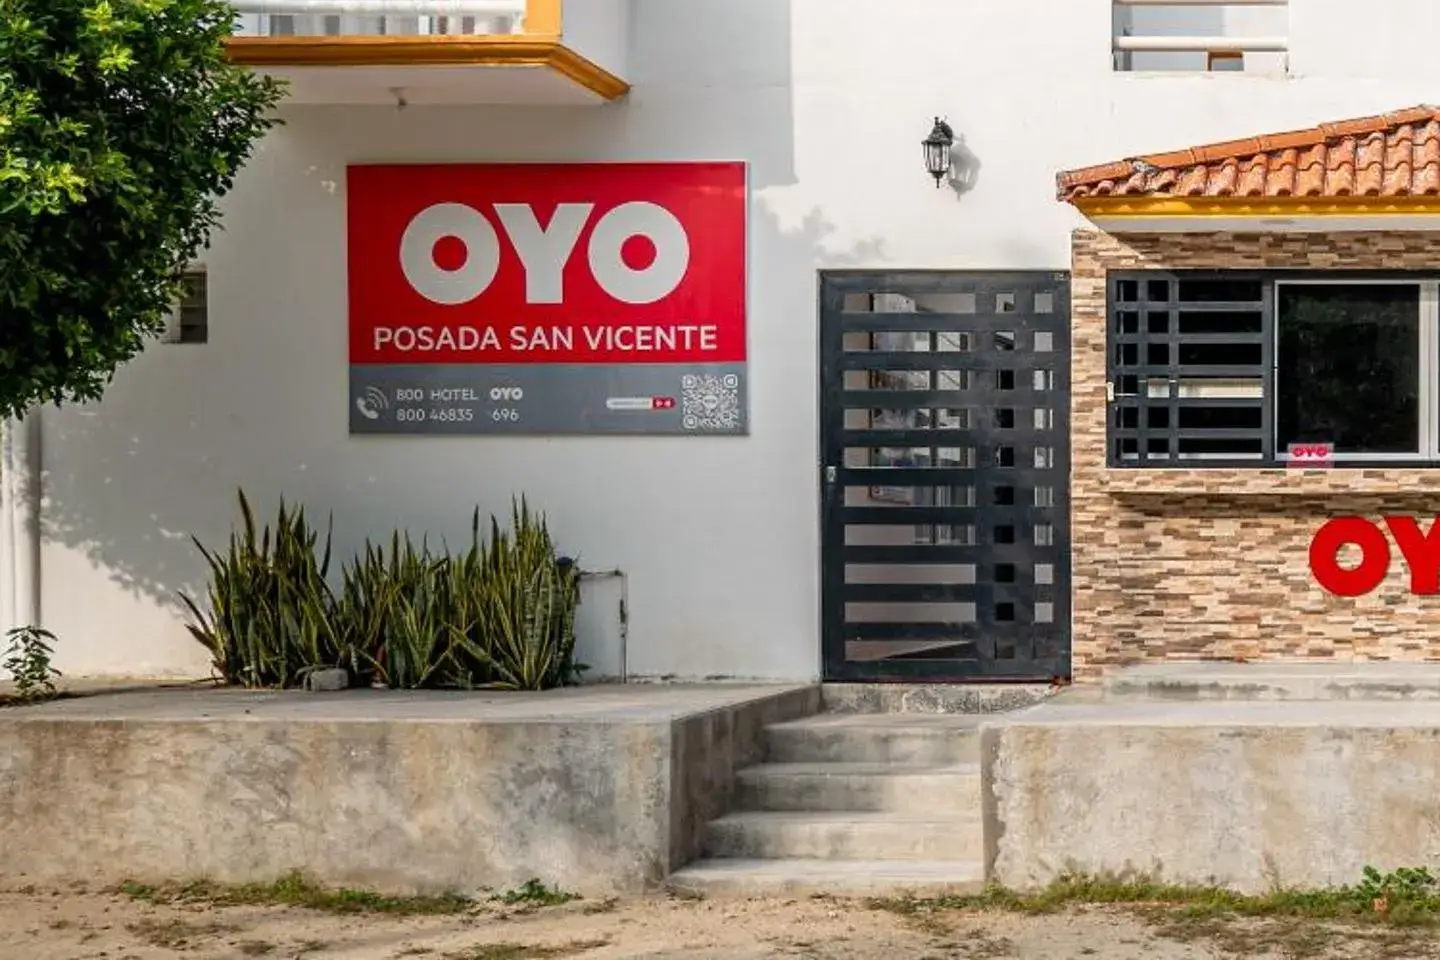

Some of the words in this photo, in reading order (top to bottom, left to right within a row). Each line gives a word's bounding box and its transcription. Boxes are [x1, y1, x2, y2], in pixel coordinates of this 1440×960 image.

[399, 201, 691, 305] OYO
[373, 326, 502, 351] POSADA
[510, 326, 573, 351] SAN
[582, 325, 718, 351] VICENTE
[396, 388, 423, 401] 800
[430, 388, 479, 401] HOTEL
[489, 387, 523, 401] OYO
[396, 408, 425, 422] 800
[429, 408, 473, 422] 46835
[492, 408, 519, 421] 696
[1292, 445, 1329, 457] OYO
